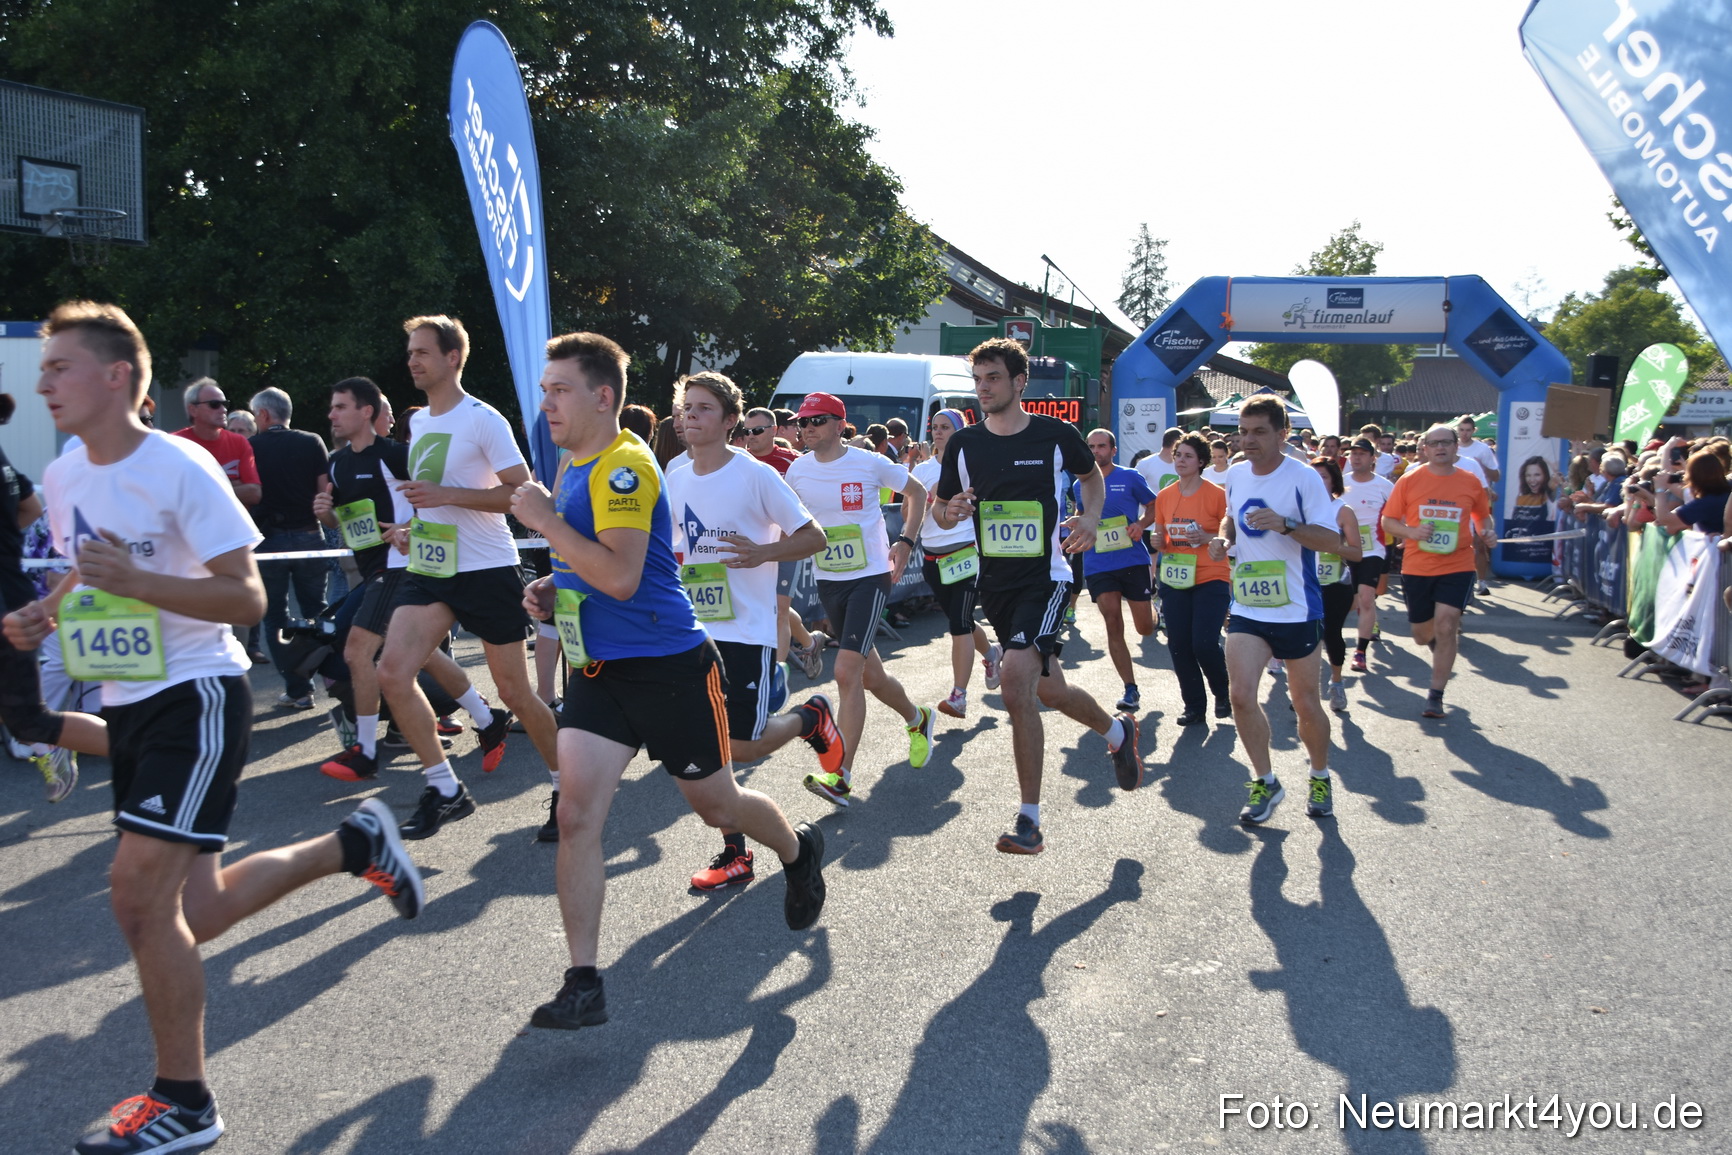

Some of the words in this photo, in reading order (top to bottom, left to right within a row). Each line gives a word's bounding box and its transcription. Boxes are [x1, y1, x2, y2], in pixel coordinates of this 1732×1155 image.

[1312, 309, 1395, 324] firmenlauf
[1162, 336, 1204, 346] Fischer
[1692, 394, 1724, 405] Jura
[1619, 398, 1652, 431] AOK
[608, 497, 641, 507] PARTL
[1422, 508, 1459, 519] OBI
[346, 518, 376, 539] 1092
[987, 523, 1038, 542] 1070
[1104, 530, 1119, 543] 10
[417, 542, 446, 563] 129
[824, 543, 855, 561] 210
[948, 559, 973, 576] 118
[1165, 566, 1189, 580] 615
[687, 586, 724, 606] 1467
[1238, 579, 1281, 597] 1481
[69, 626, 152, 657] 1468
